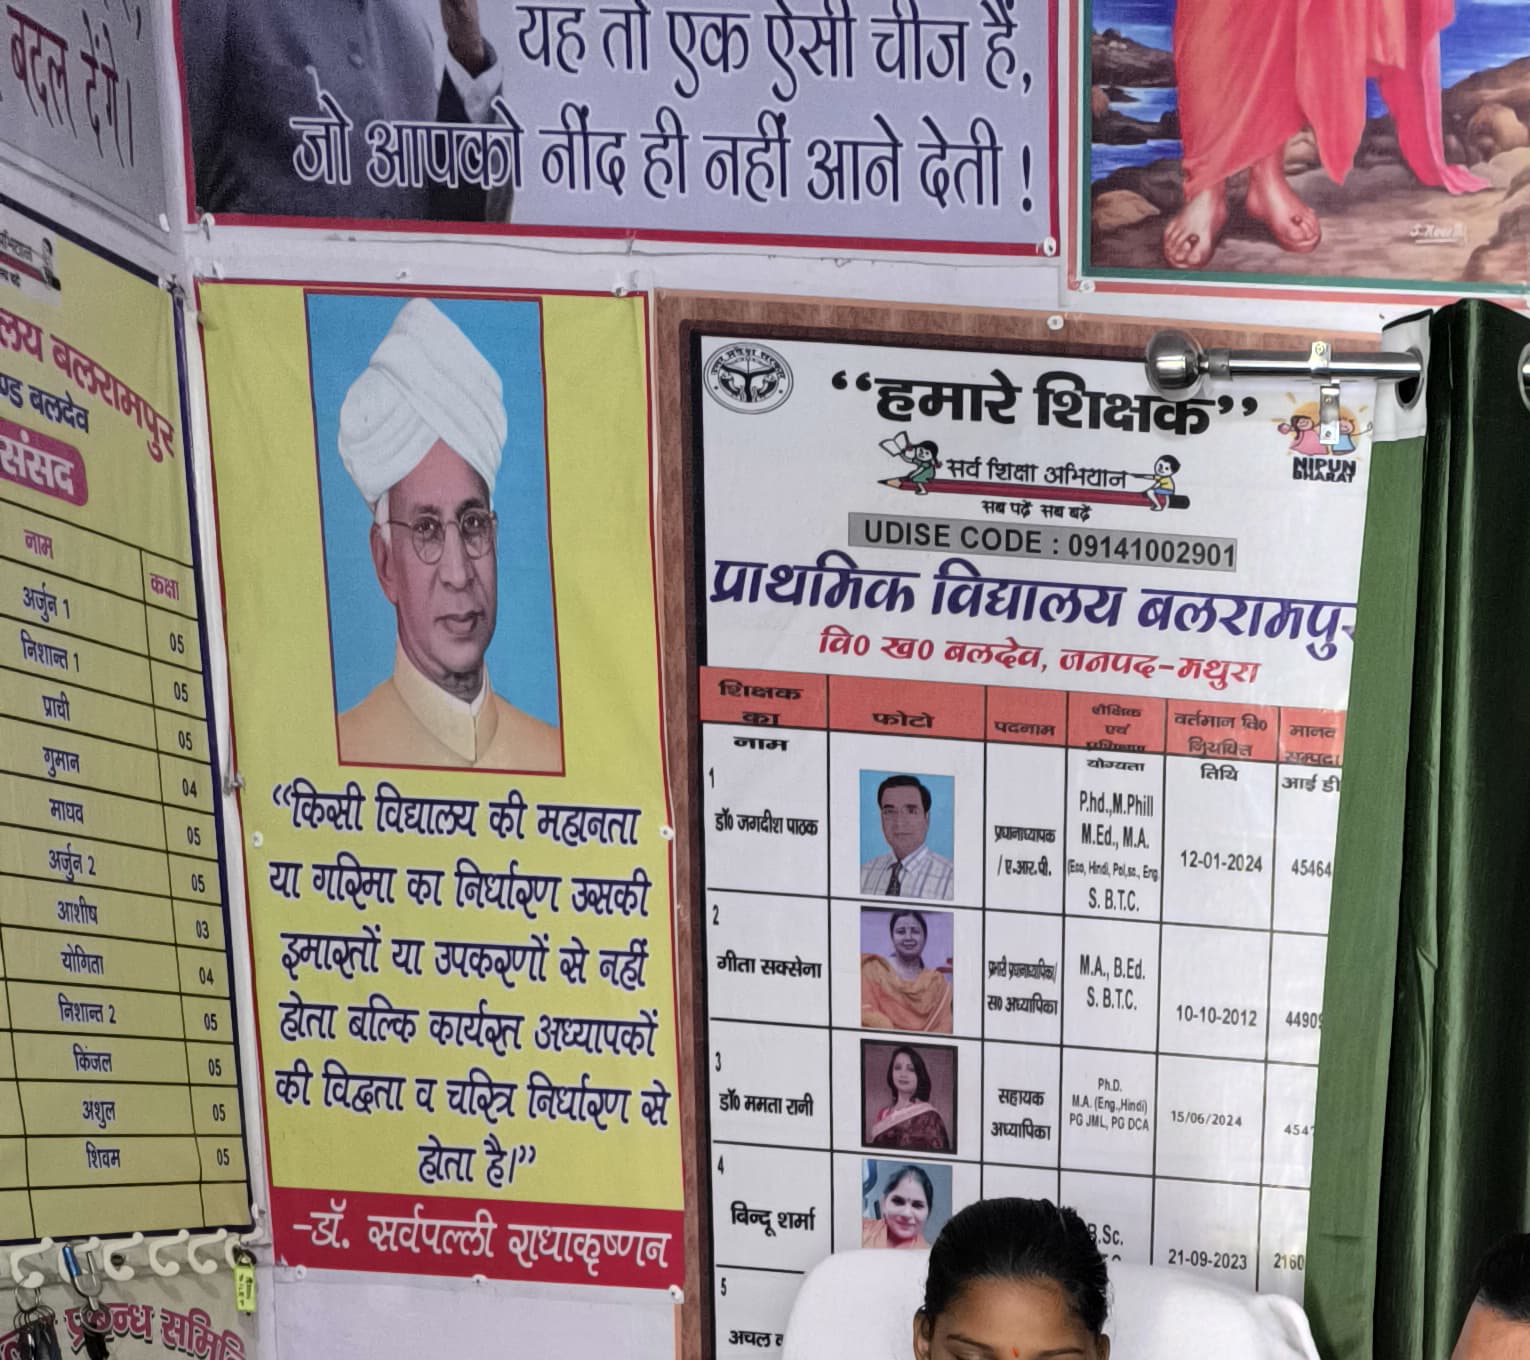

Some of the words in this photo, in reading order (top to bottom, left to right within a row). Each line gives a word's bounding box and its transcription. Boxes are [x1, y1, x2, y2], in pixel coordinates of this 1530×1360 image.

[517, 5, 587, 74] यह
[668, 13, 750, 98] एक
[872, 0, 968, 83] चीज
[7, 6, 77, 138] बदल
[291, 94, 352, 186] जो
[366, 98, 523, 192] आपको
[538, 103, 627, 198] नींद
[643, 105, 688, 200] ही
[703, 109, 790, 204] नहीं
[807, 114, 903, 204] आने
[917, 116, 1003, 208] देती
[28, 384, 90, 434] बलदेव
[50, 334, 175, 463] बलरामपुर
[946, 456, 983, 481] सर्व
[986, 458, 1037, 484] शिक्षा
[1044, 463, 1128, 489] अभियान
[1292, 457, 1357, 475] NIPUN
[864, 519, 951, 548] UDISE
[960, 526, 1042, 554] CODE
[1068, 533, 1236, 568] 09141002901
[24, 528, 54, 560] नाम
[150, 572, 180, 601] कक्षा
[709, 549, 921, 612] प्राथमिक
[931, 557, 1128, 627] विद्यालय
[22, 582, 58, 622] अर्जुन
[63, 599, 70, 619] 1
[169, 632, 185, 654] 05
[21, 629, 68, 671] निशान्त
[73, 653, 80, 673] 1
[174, 681, 189, 703] 05
[943, 636, 1048, 673] बलदेव,
[42, 690, 71, 722] प्राची
[178, 731, 193, 751] 05
[42, 746, 80, 778] गुमान
[182, 780, 198, 799] 04
[49, 798, 84, 825] माधव
[374, 780, 479, 838] विद्यालय
[488, 788, 526, 840] की
[536, 803, 641, 846] महानता
[736, 808, 784, 835] जगदीश
[786, 818, 820, 836] पाठक
[1122, 826, 1150, 850] M.A.
[48, 842, 84, 882] अर्जुन
[88, 856, 97, 877] 2
[1179, 849, 1263, 874] 12-01-2024
[268, 860, 303, 899] या
[311, 851, 397, 910] गरिमा
[406, 868, 444, 907] का
[454, 857, 561, 919] निर्धारण
[570, 867, 652, 917] उसकी
[57, 895, 98, 926] आशीष
[196, 919, 210, 940] 03
[61, 942, 105, 976] योगिता
[280, 925, 382, 981] इमारतों
[391, 938, 425, 976] या
[433, 933, 550, 987] उपकरणों
[559, 936, 590, 984] से
[599, 938, 650, 991] नहीं
[716, 949, 756, 976] गीता
[760, 955, 822, 980] सक्सेना
[1113, 956, 1146, 981] B.Ed.
[58, 991, 105, 1025] निशान्त
[108, 1003, 117, 1025] 2
[279, 990, 337, 1041] होता
[347, 993, 419, 1039] बल्कि
[428, 999, 525, 1056] कार्यरत
[534, 1009, 659, 1057] अध्यापकों
[1175, 1003, 1258, 1028] 10-10-2012
[73, 1042, 113, 1074] किंजल
[274, 1058, 314, 1106] की
[415, 1078, 437, 1113] व
[445, 1067, 518, 1124] चरित्र
[526, 1068, 632, 1131] निर्धारण
[641, 1081, 672, 1126] से
[744, 1094, 782, 1116] ममता
[786, 1091, 814, 1117] रानी
[997, 1087, 1046, 1108] सहायक
[990, 1117, 1052, 1141] अध्यापिका
[1170, 1109, 1243, 1128] 15/06/2024
[86, 1140, 121, 1169] शिवम
[417, 1135, 476, 1184] होता
[777, 1206, 816, 1231] शर्मा
[367, 1204, 498, 1259] सर्वपल्ली
[507, 1222, 672, 1277] राधाकृष्णन
[1168, 1248, 1248, 1271] 21-09-2023
